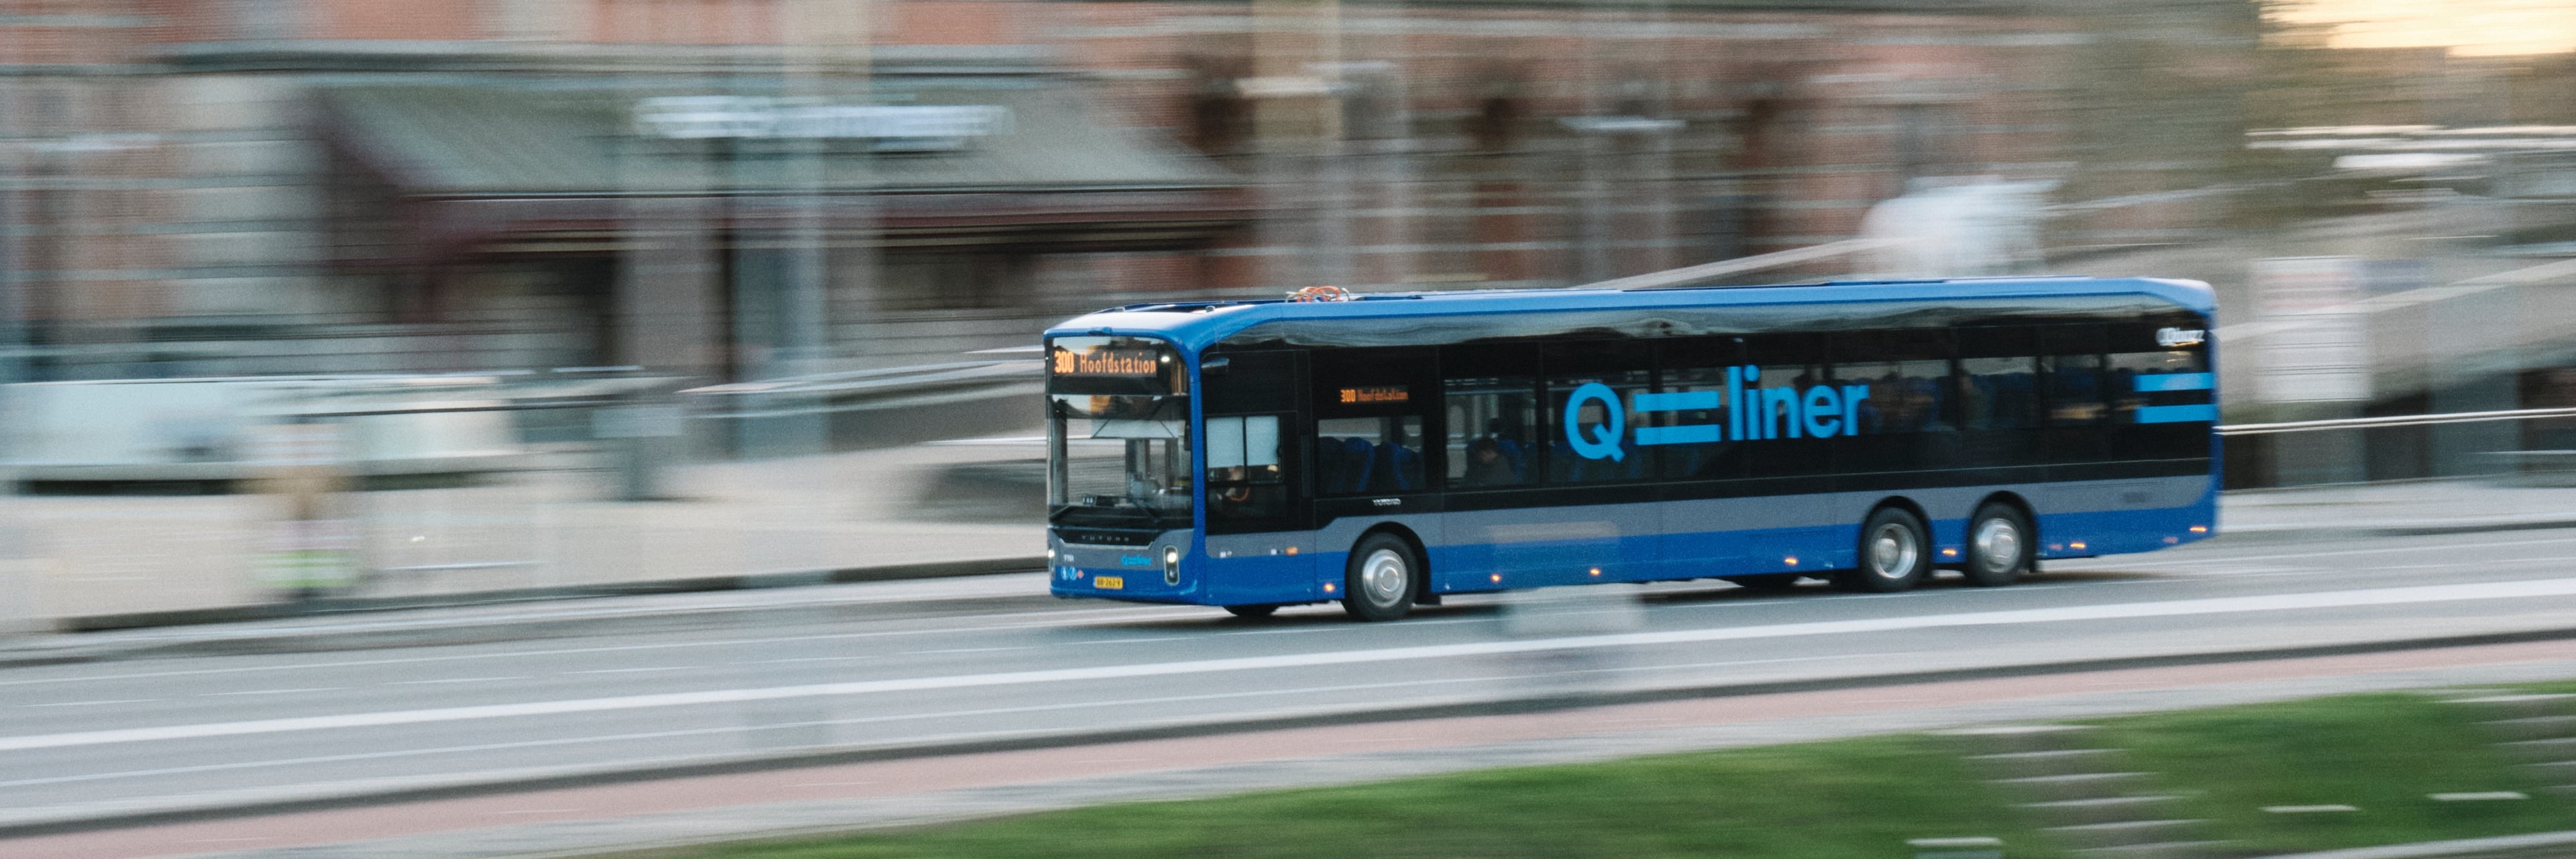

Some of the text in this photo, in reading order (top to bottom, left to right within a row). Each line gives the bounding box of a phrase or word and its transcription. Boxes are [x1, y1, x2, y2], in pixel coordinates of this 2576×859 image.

[1054, 350, 1157, 374] 300 Hoofdstation
[1340, 389, 1356, 402] 300
